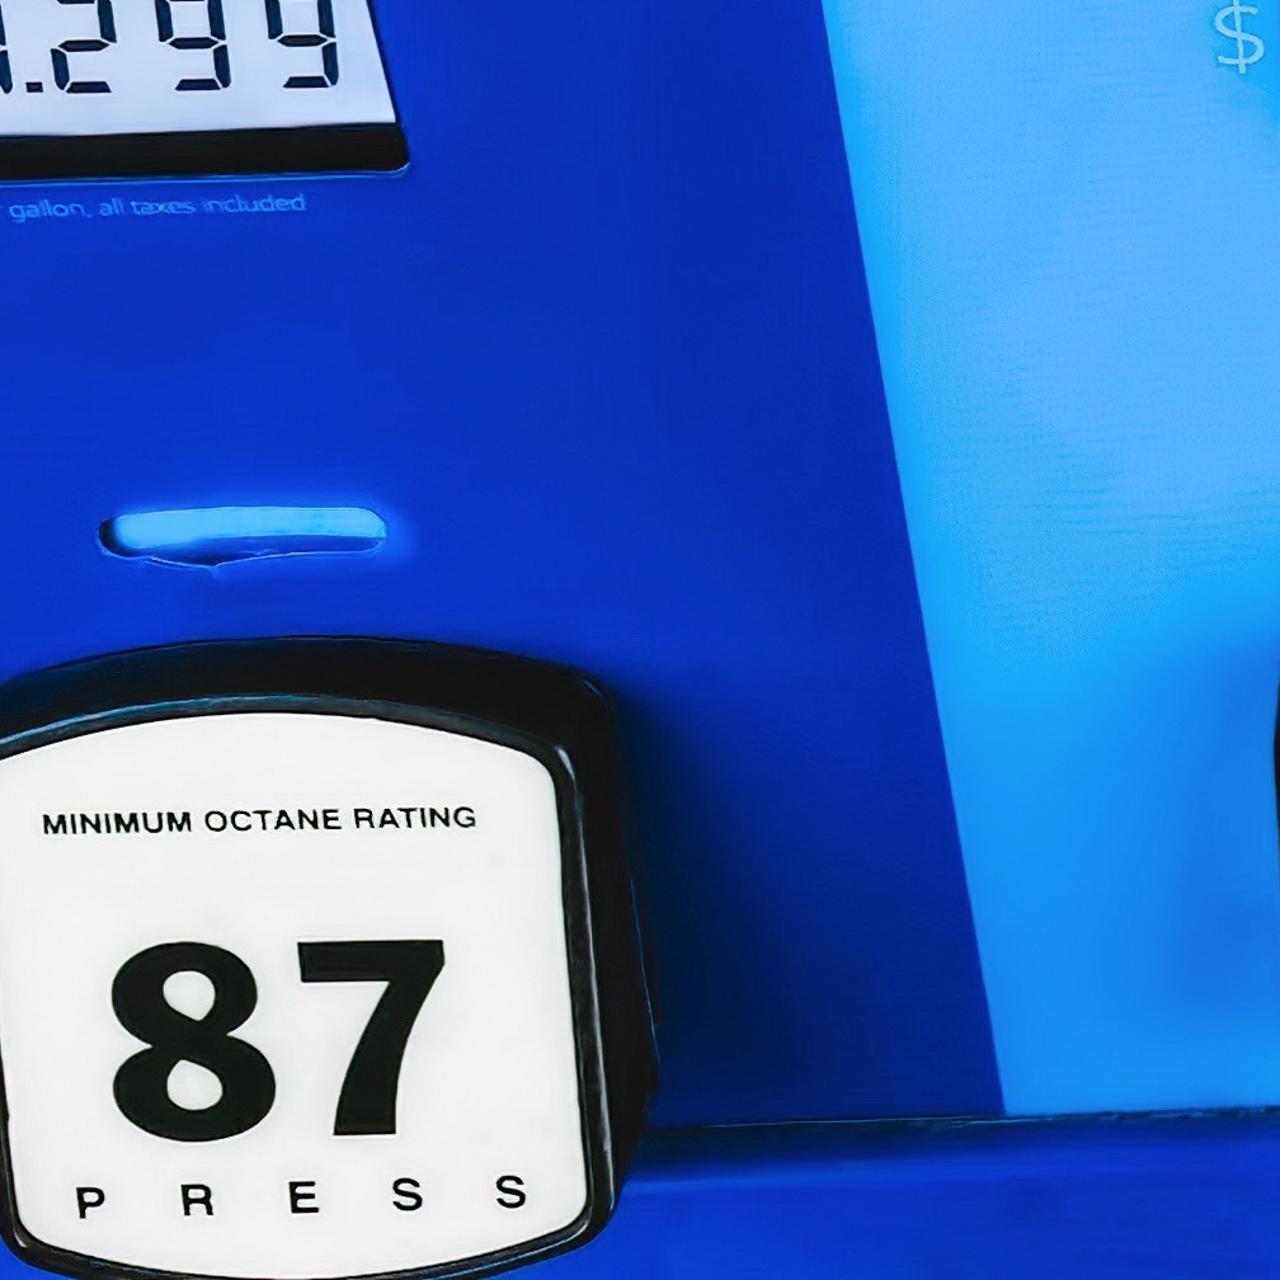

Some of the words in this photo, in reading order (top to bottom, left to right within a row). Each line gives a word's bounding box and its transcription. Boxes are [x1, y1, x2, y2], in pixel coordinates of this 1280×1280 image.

[9, 199, 92, 223] gallon,
[98, 197, 125, 216] all
[130, 198, 197, 215] taxes
[203, 193, 307, 213] included
[42, 811, 192, 835] MINIMUM
[204, 808, 342, 833] OCTANE
[353, 806, 476, 829] RATING
[111, 939, 445, 1143] 87
[76, 1175, 526, 1219] PRESS
